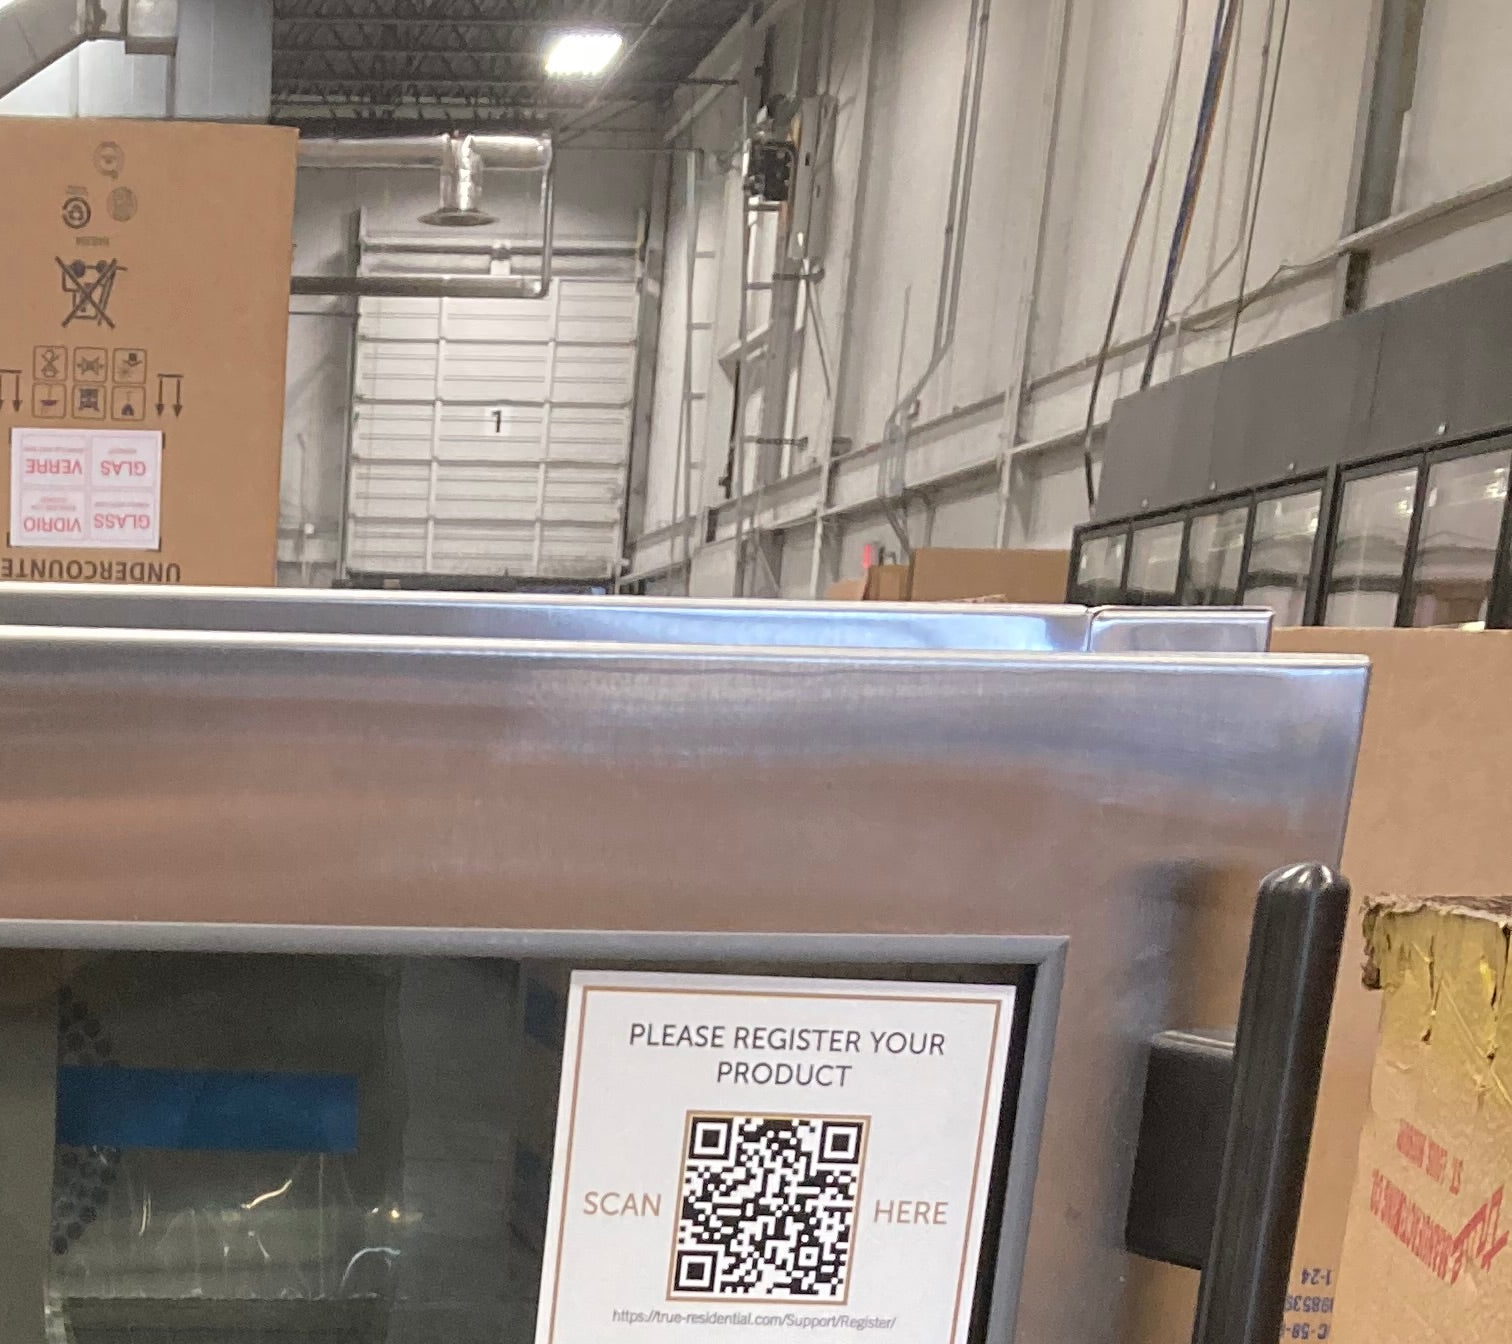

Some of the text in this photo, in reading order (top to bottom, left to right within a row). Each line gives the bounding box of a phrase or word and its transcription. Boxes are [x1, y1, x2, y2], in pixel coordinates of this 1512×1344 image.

[491, 410, 503, 433] 1
[25, 457, 82, 475] VERRE
[100, 459, 147, 477] GLAS
[23, 515, 82, 533] VIDRIO
[93, 512, 151, 530] GLASS
[629, 1023, 946, 1056] PLEASE REGISTER YOUR
[717, 1062, 852, 1088] PRODUCT
[583, 1190, 662, 1217] SCAN
[873, 1199, 949, 1226] HERE
[612, 1308, 897, 1331] https://true-residential.com/Support/Register/
